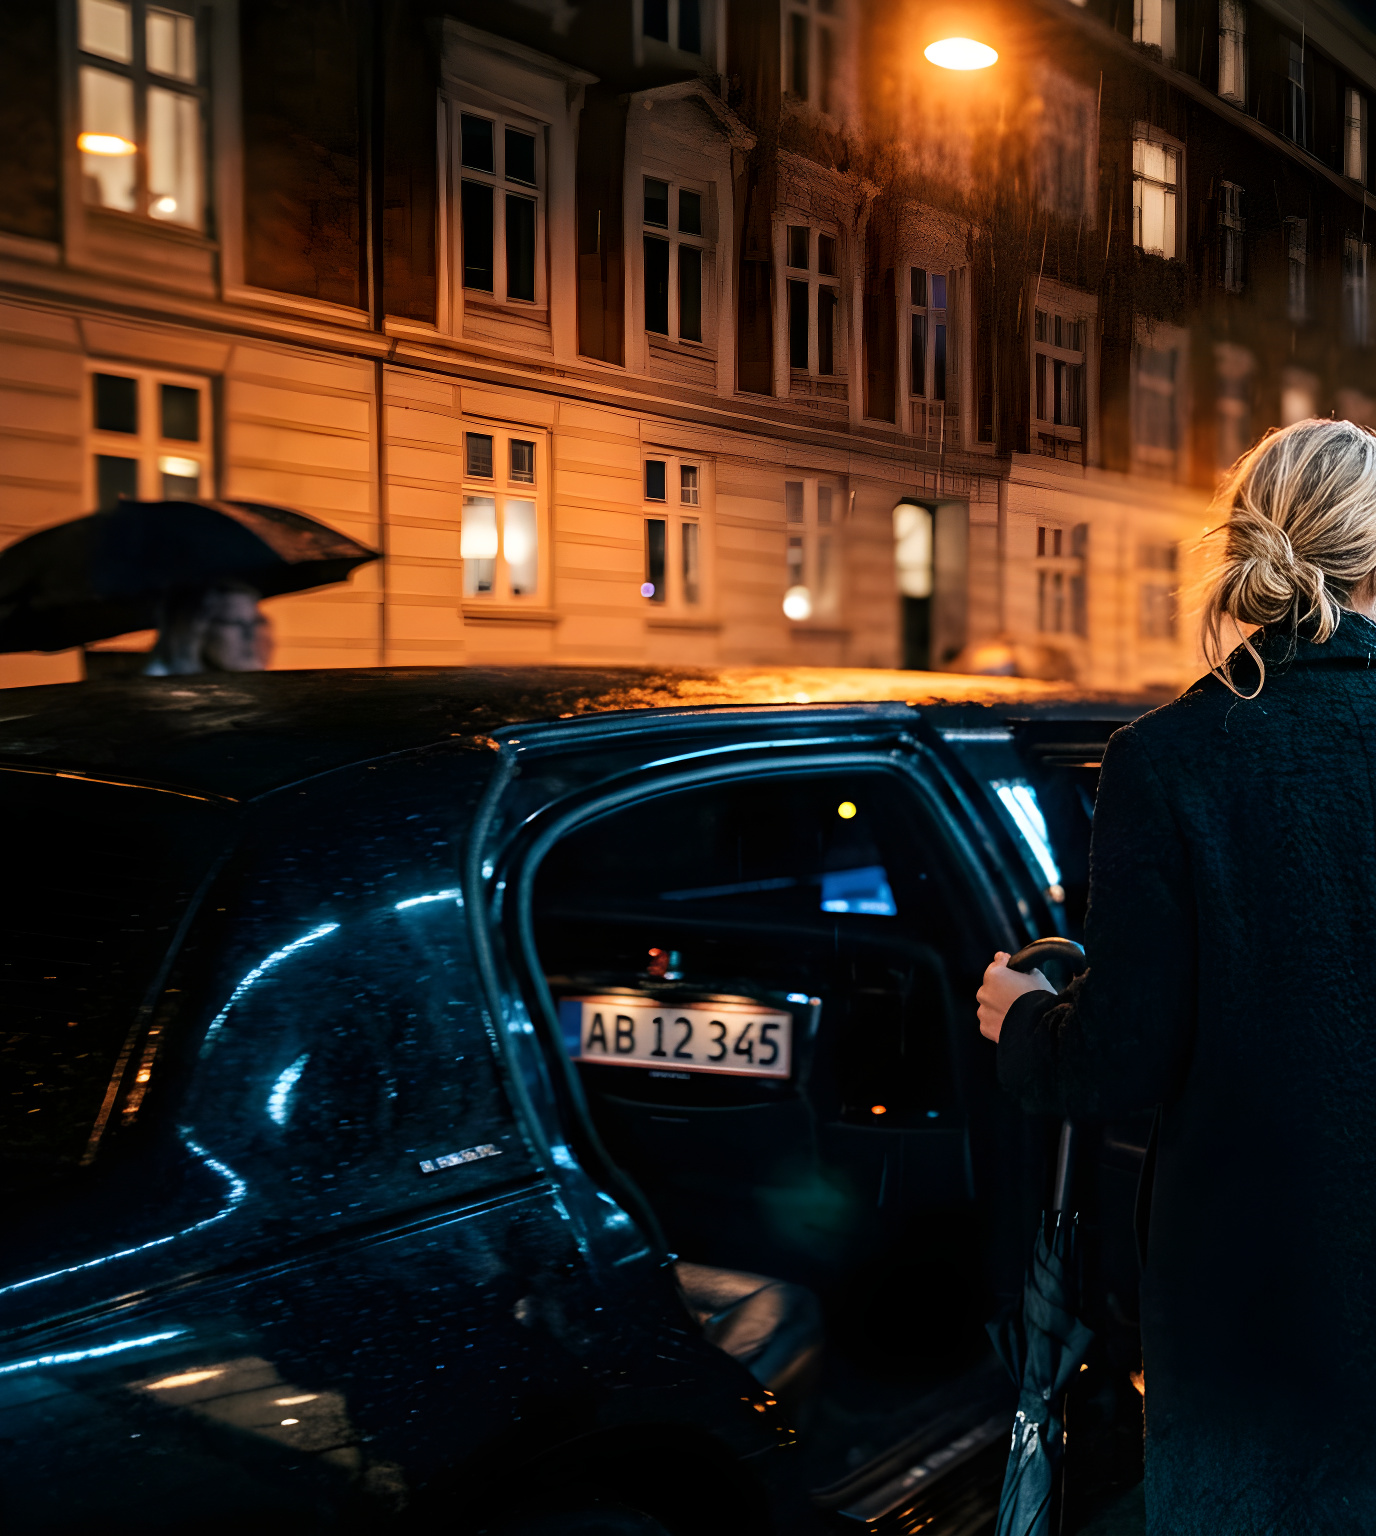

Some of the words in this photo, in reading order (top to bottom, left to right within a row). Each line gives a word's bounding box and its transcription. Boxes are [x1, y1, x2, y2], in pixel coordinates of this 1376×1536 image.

[587, 1013, 636, 1055] AB
[650, 1016, 693, 1059] 12
[708, 1020, 780, 1065] 345
